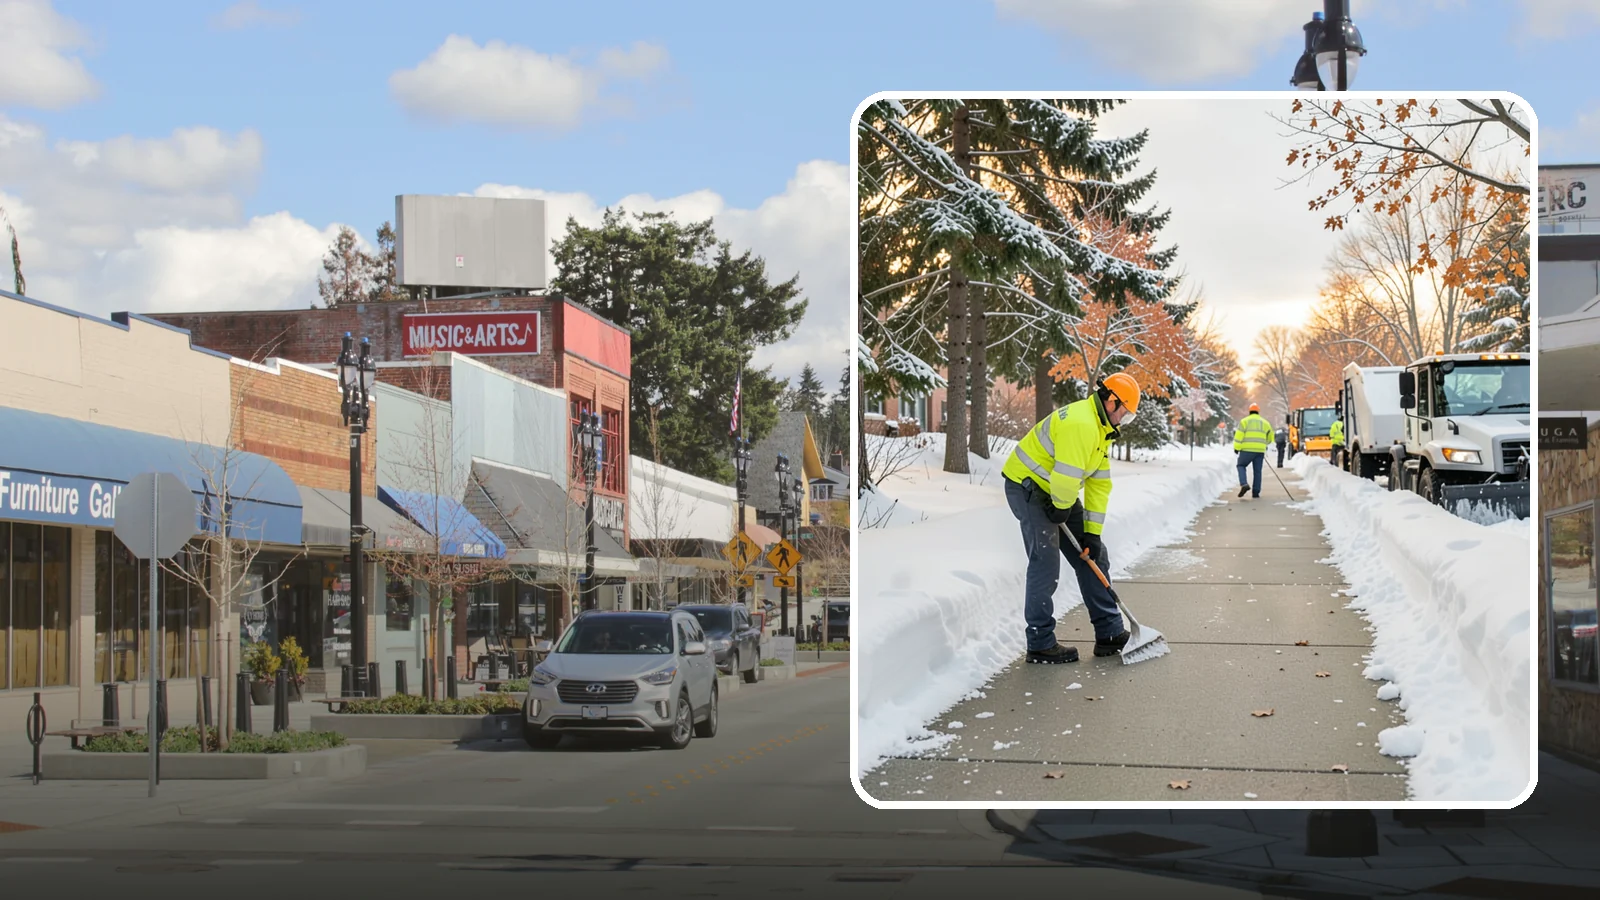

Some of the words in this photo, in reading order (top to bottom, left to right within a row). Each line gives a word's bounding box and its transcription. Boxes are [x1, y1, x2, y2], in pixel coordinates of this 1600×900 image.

[409, 323, 519, 349] MUSIC&ARTS
[0, 472, 79, 515] Furniture
[453, 563, 479, 574] SUSHI
